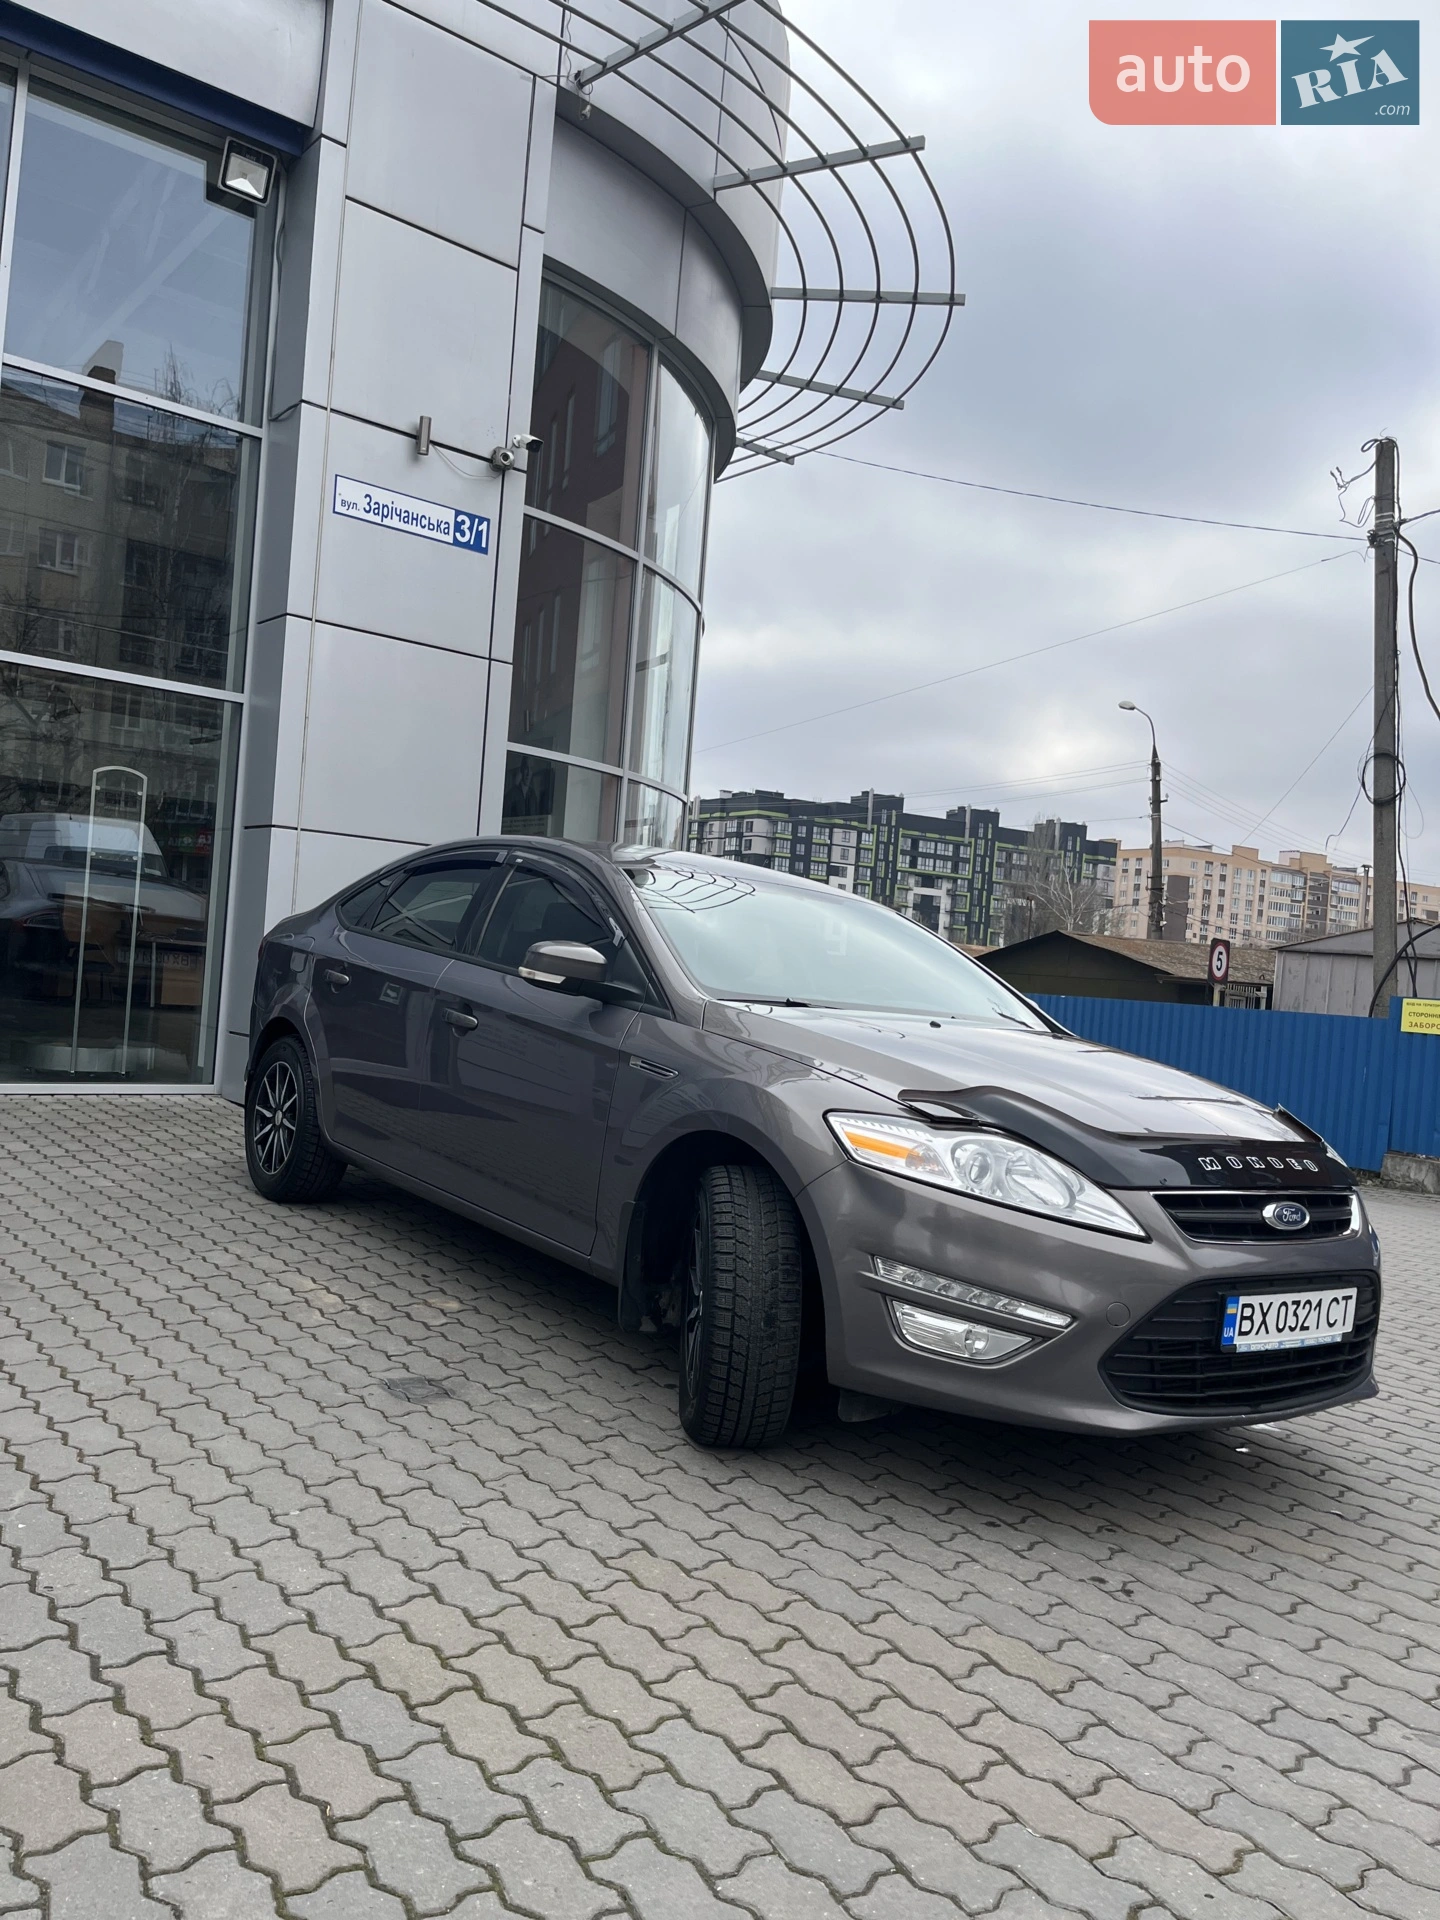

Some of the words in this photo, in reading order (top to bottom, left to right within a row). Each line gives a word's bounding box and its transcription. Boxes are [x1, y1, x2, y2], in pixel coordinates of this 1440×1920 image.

[340, 498, 360, 512] вул.
[363, 493, 450, 536] Зарічанська
[455, 514, 488, 548] 3/1
[1215, 951, 1223, 971] 5
[1198, 1156, 1319, 1172] MONDEO
[1282, 1207, 1301, 1222] Ford
[1223, 1327, 1234, 1338] UA
